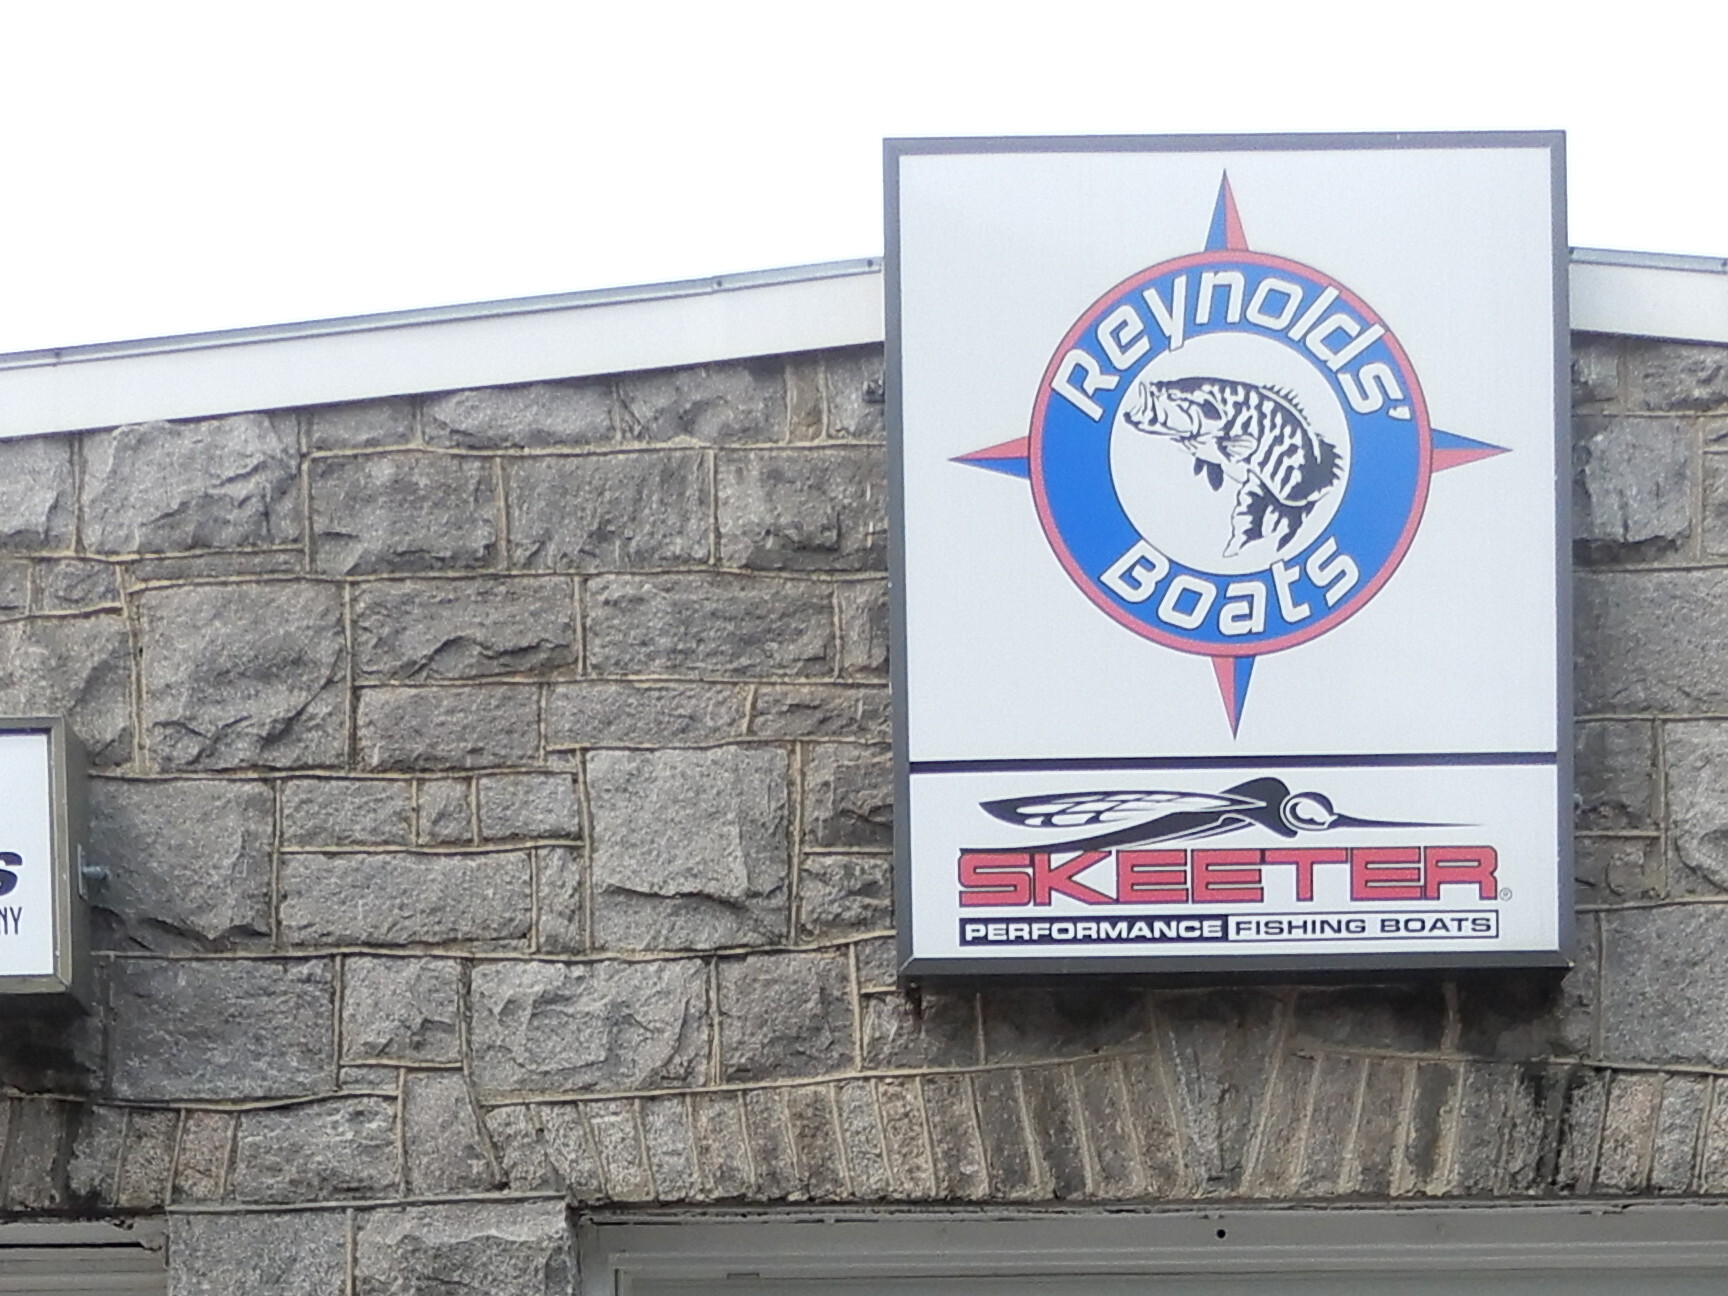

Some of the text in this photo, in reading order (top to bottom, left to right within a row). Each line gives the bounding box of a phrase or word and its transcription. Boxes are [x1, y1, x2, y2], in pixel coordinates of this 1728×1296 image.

[1099, 535, 1360, 638] Boats
[957, 845, 1499, 907] SKEETER
[964, 915, 1493, 942] PERFORMANCE FISHING BOATS
